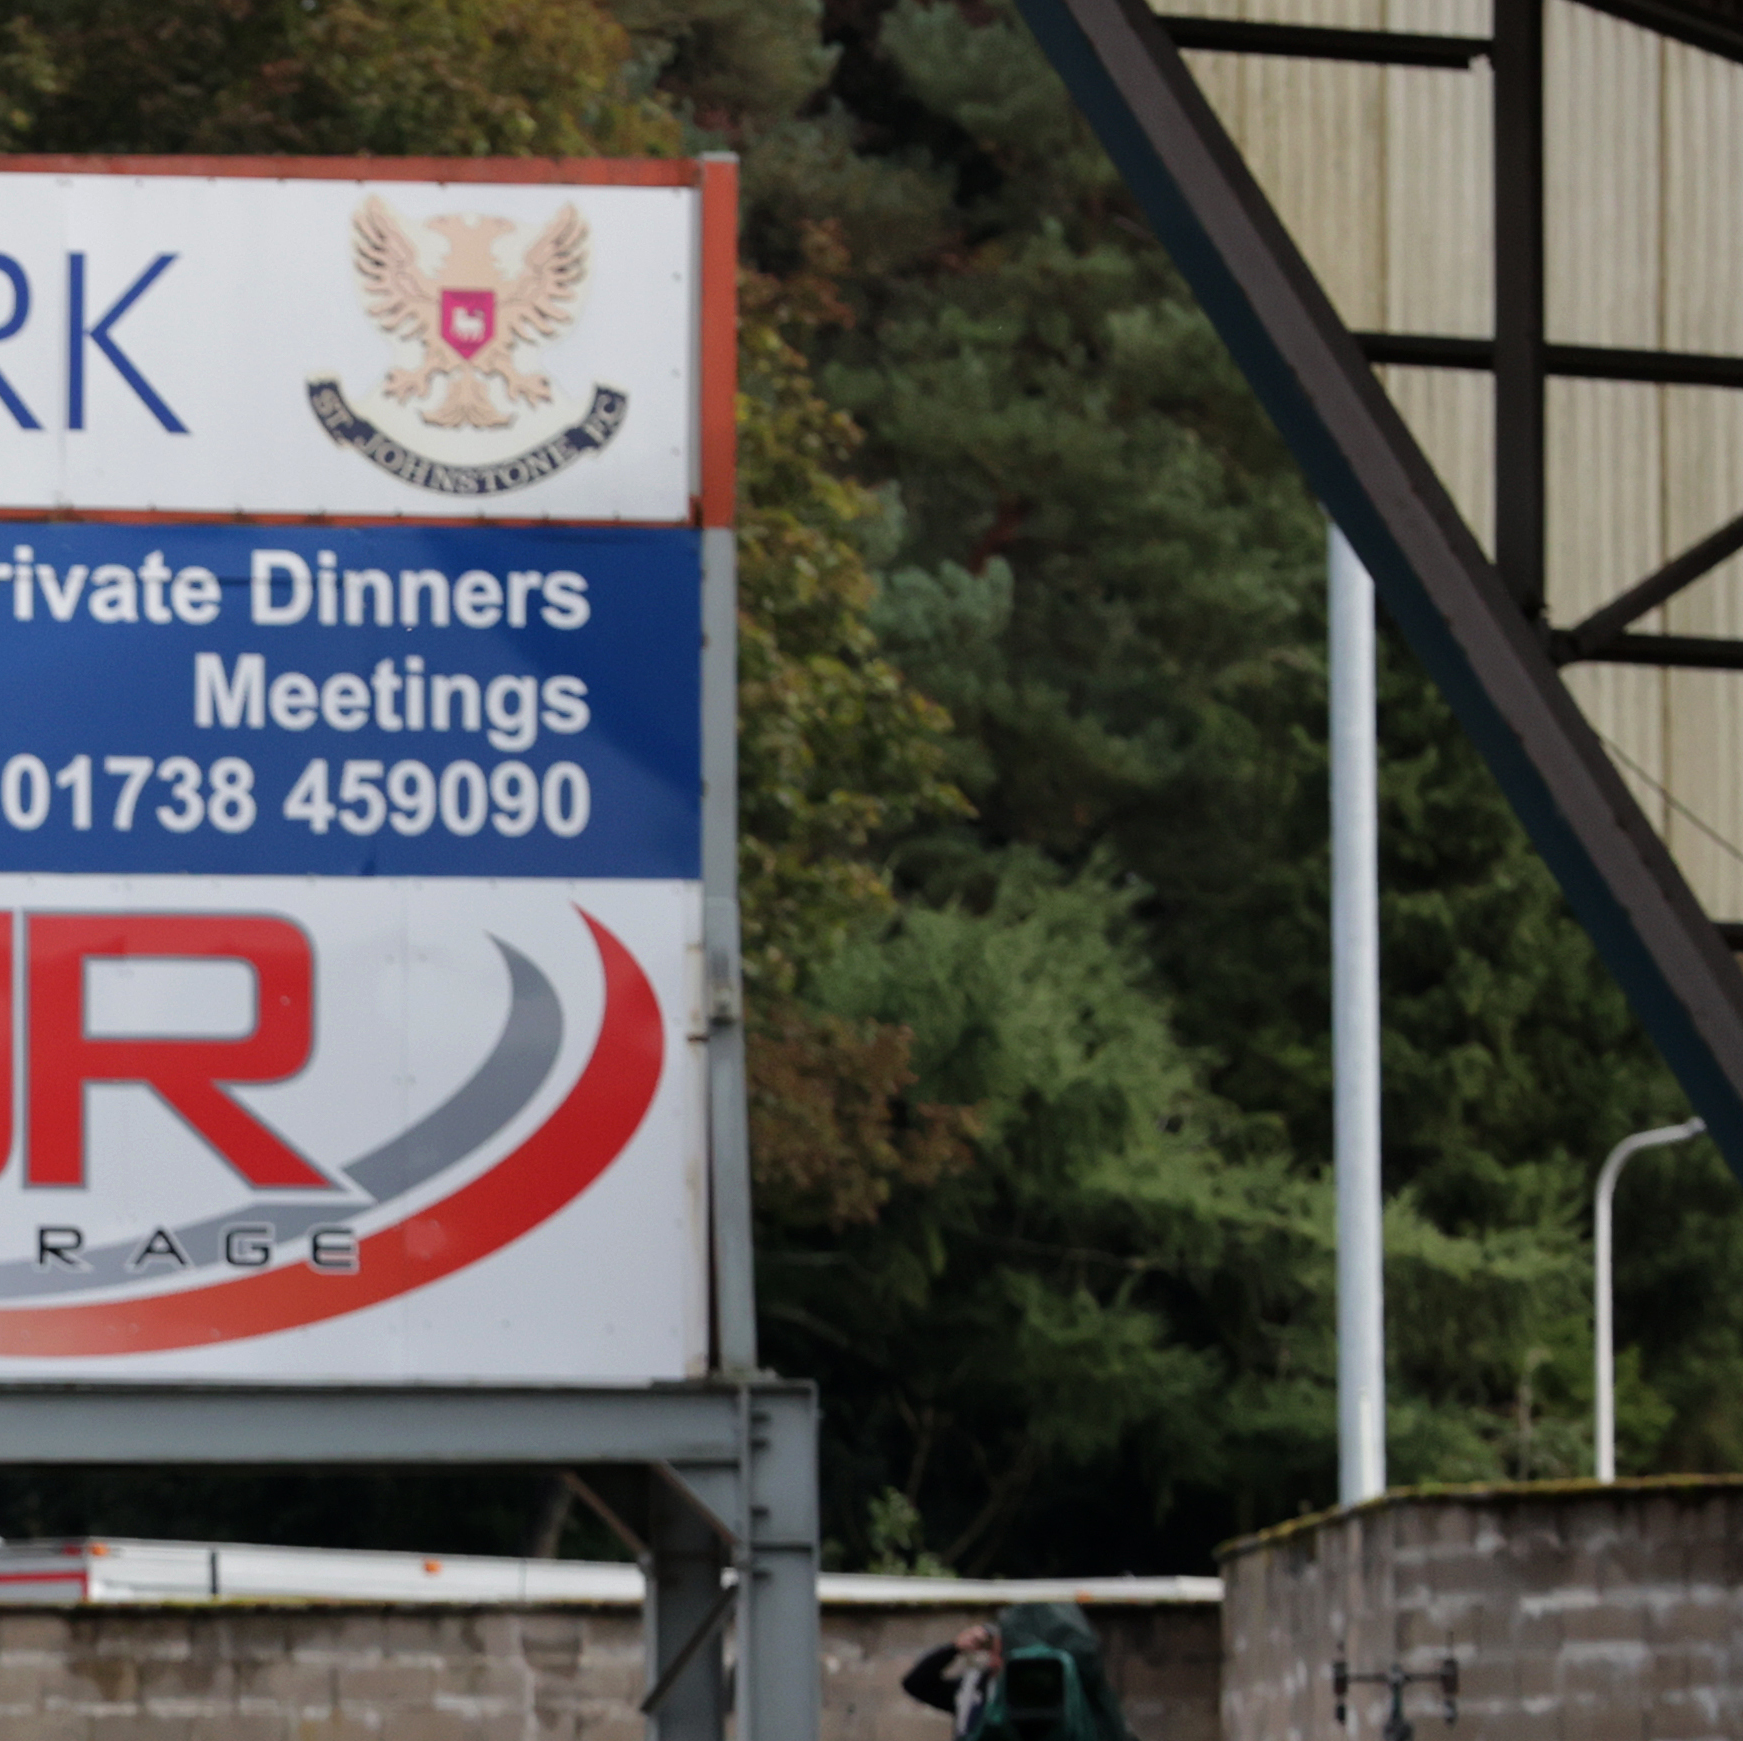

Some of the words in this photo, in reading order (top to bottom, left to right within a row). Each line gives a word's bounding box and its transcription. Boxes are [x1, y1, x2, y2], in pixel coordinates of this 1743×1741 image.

[353, 433, 576, 495] JOHNSTONE
[252, 548, 591, 630] Dinners
[194, 650, 591, 751] Meetings
[0, 752, 257, 833] 01738
[283, 759, 591, 838] 459090
